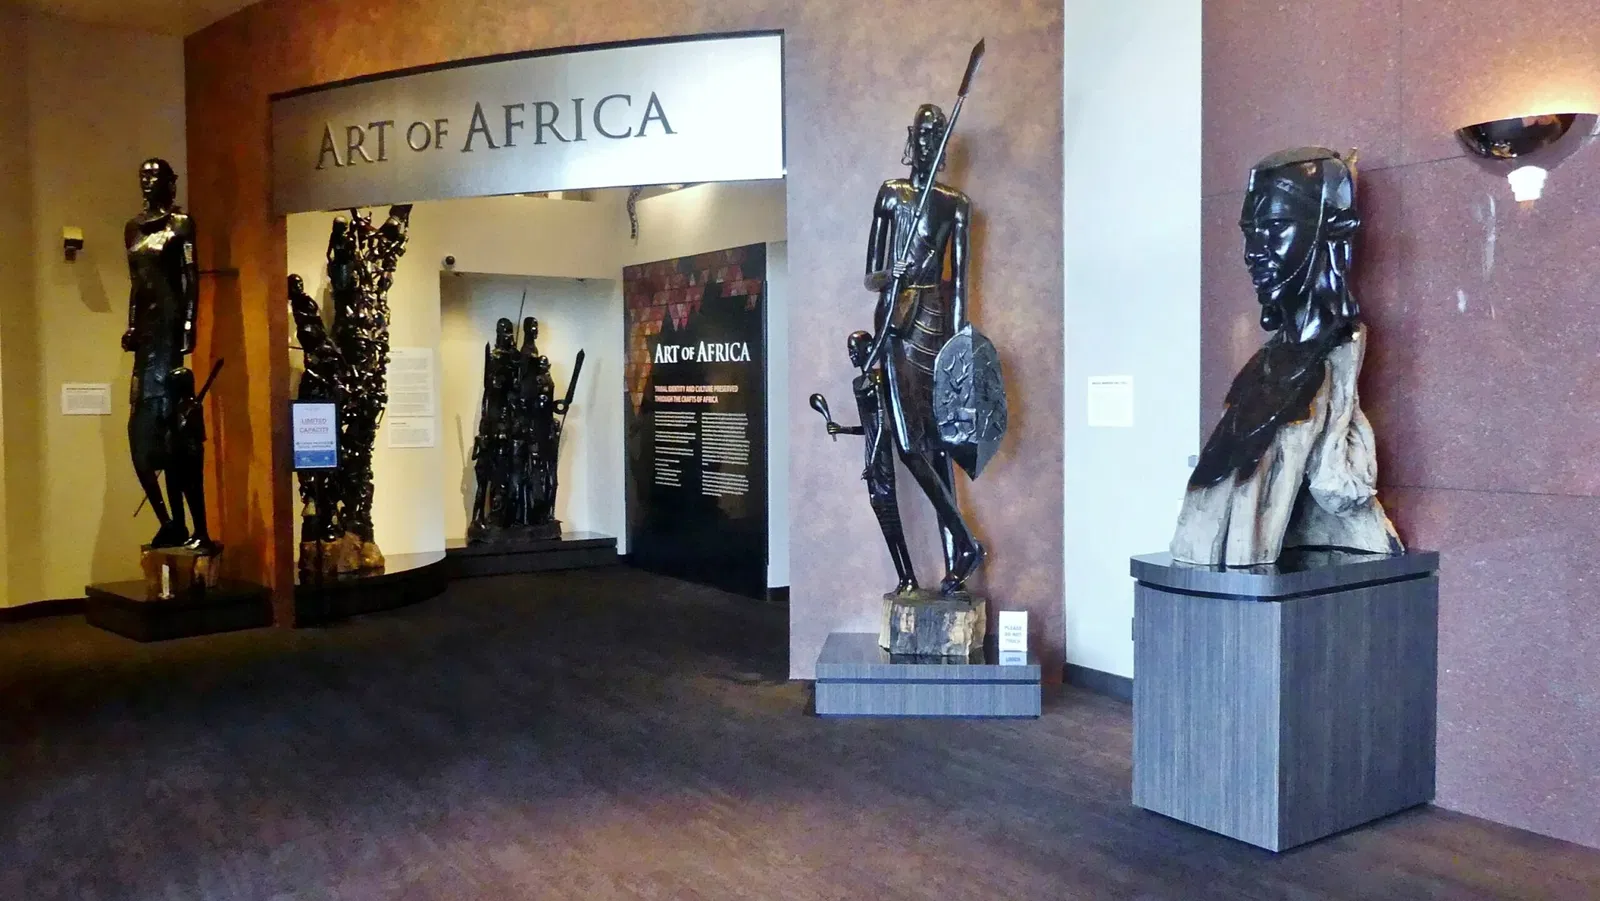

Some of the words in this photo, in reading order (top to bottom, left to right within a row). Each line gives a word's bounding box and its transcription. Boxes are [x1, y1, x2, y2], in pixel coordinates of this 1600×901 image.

[315, 120, 394, 170] ART
[406, 118, 449, 152] OF
[460, 91, 678, 152] AFRICA
[654, 343, 680, 364] ART
[681, 346, 695, 361] OF
[696, 340, 751, 363] AFRICA
[702, 395, 719, 403] AFRICA
